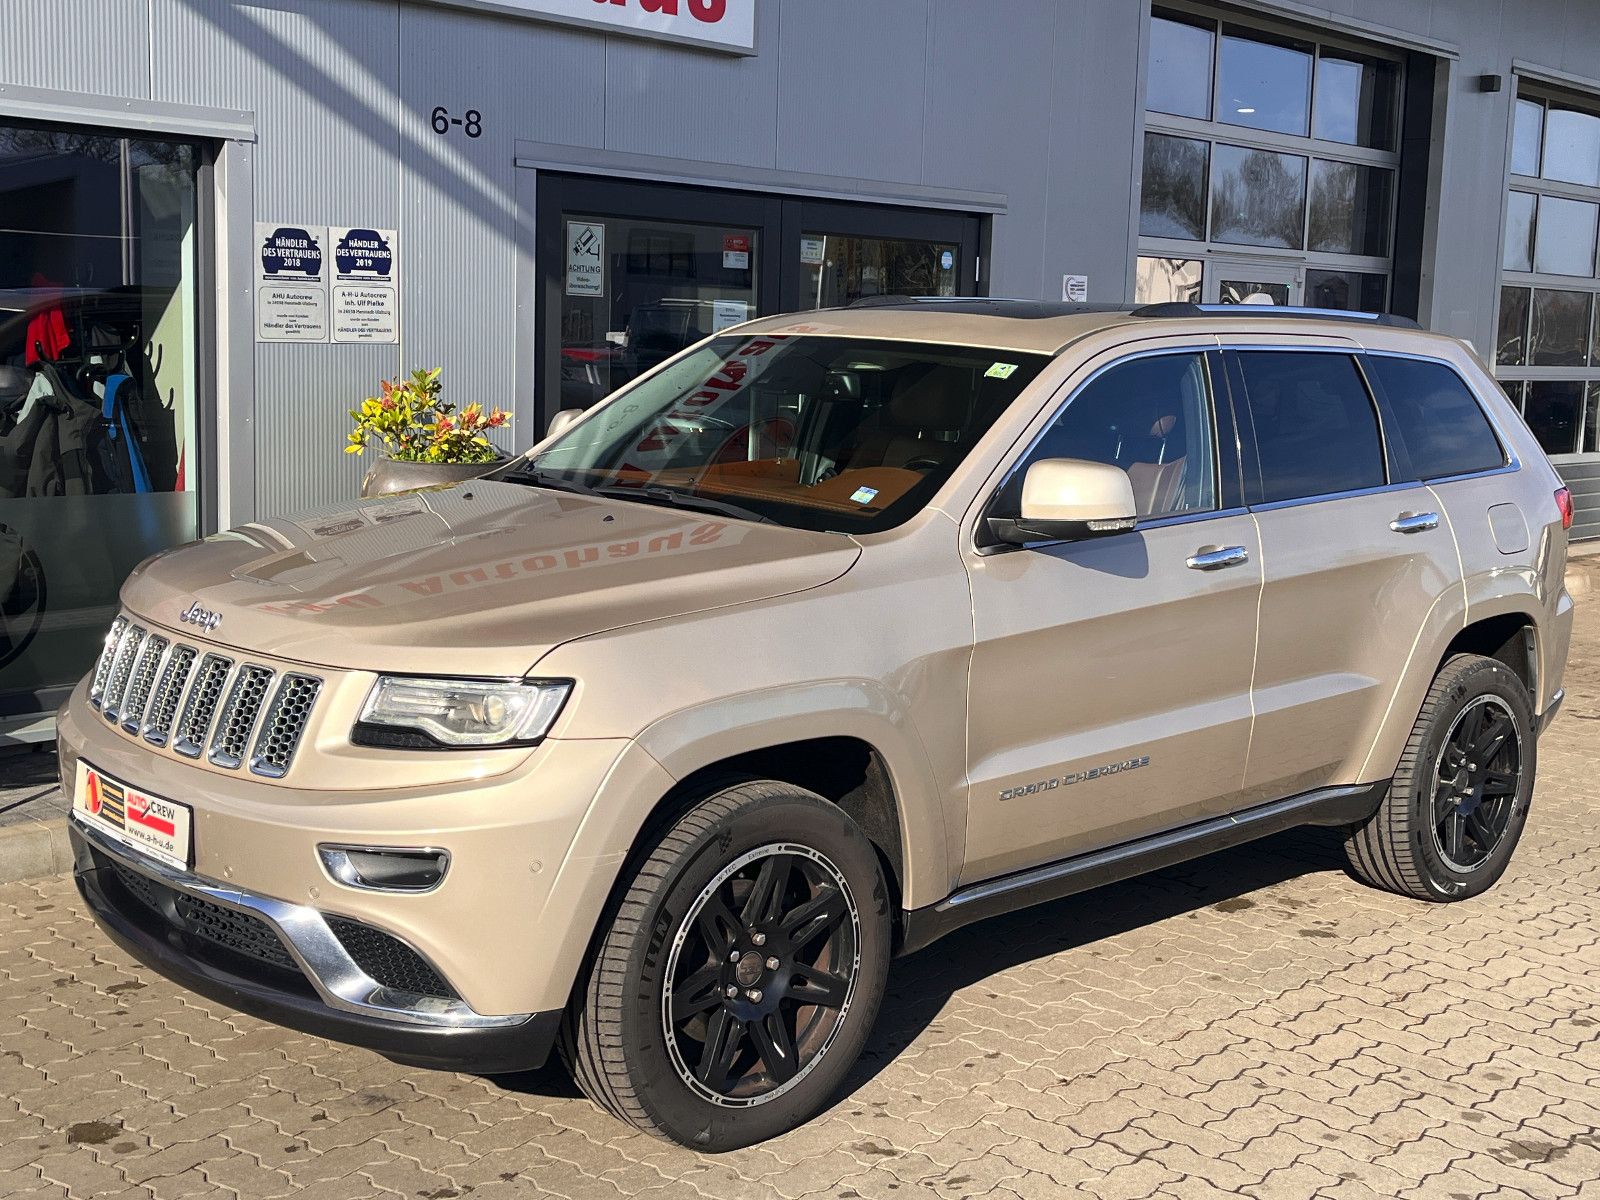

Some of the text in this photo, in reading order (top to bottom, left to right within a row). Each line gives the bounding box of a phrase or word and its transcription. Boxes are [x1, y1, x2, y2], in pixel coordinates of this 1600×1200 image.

[431, 106, 482, 138] 6-8
[275, 237, 308, 248] HÄNDLER
[349, 239, 379, 249] HÄNDLER
[263, 247, 321, 259] DES VERTRAUENS
[336, 248, 391, 259] DES VERTRAUENS
[283, 258, 301, 267] 2018
[355, 258, 373, 267] 2019
[568, 264, 601, 273] ACHTUNG
[179, 600, 223, 634] Jeep
[999, 755, 1150, 801] GRAND CHEROKEE
[150, 801, 175, 820] CREW
